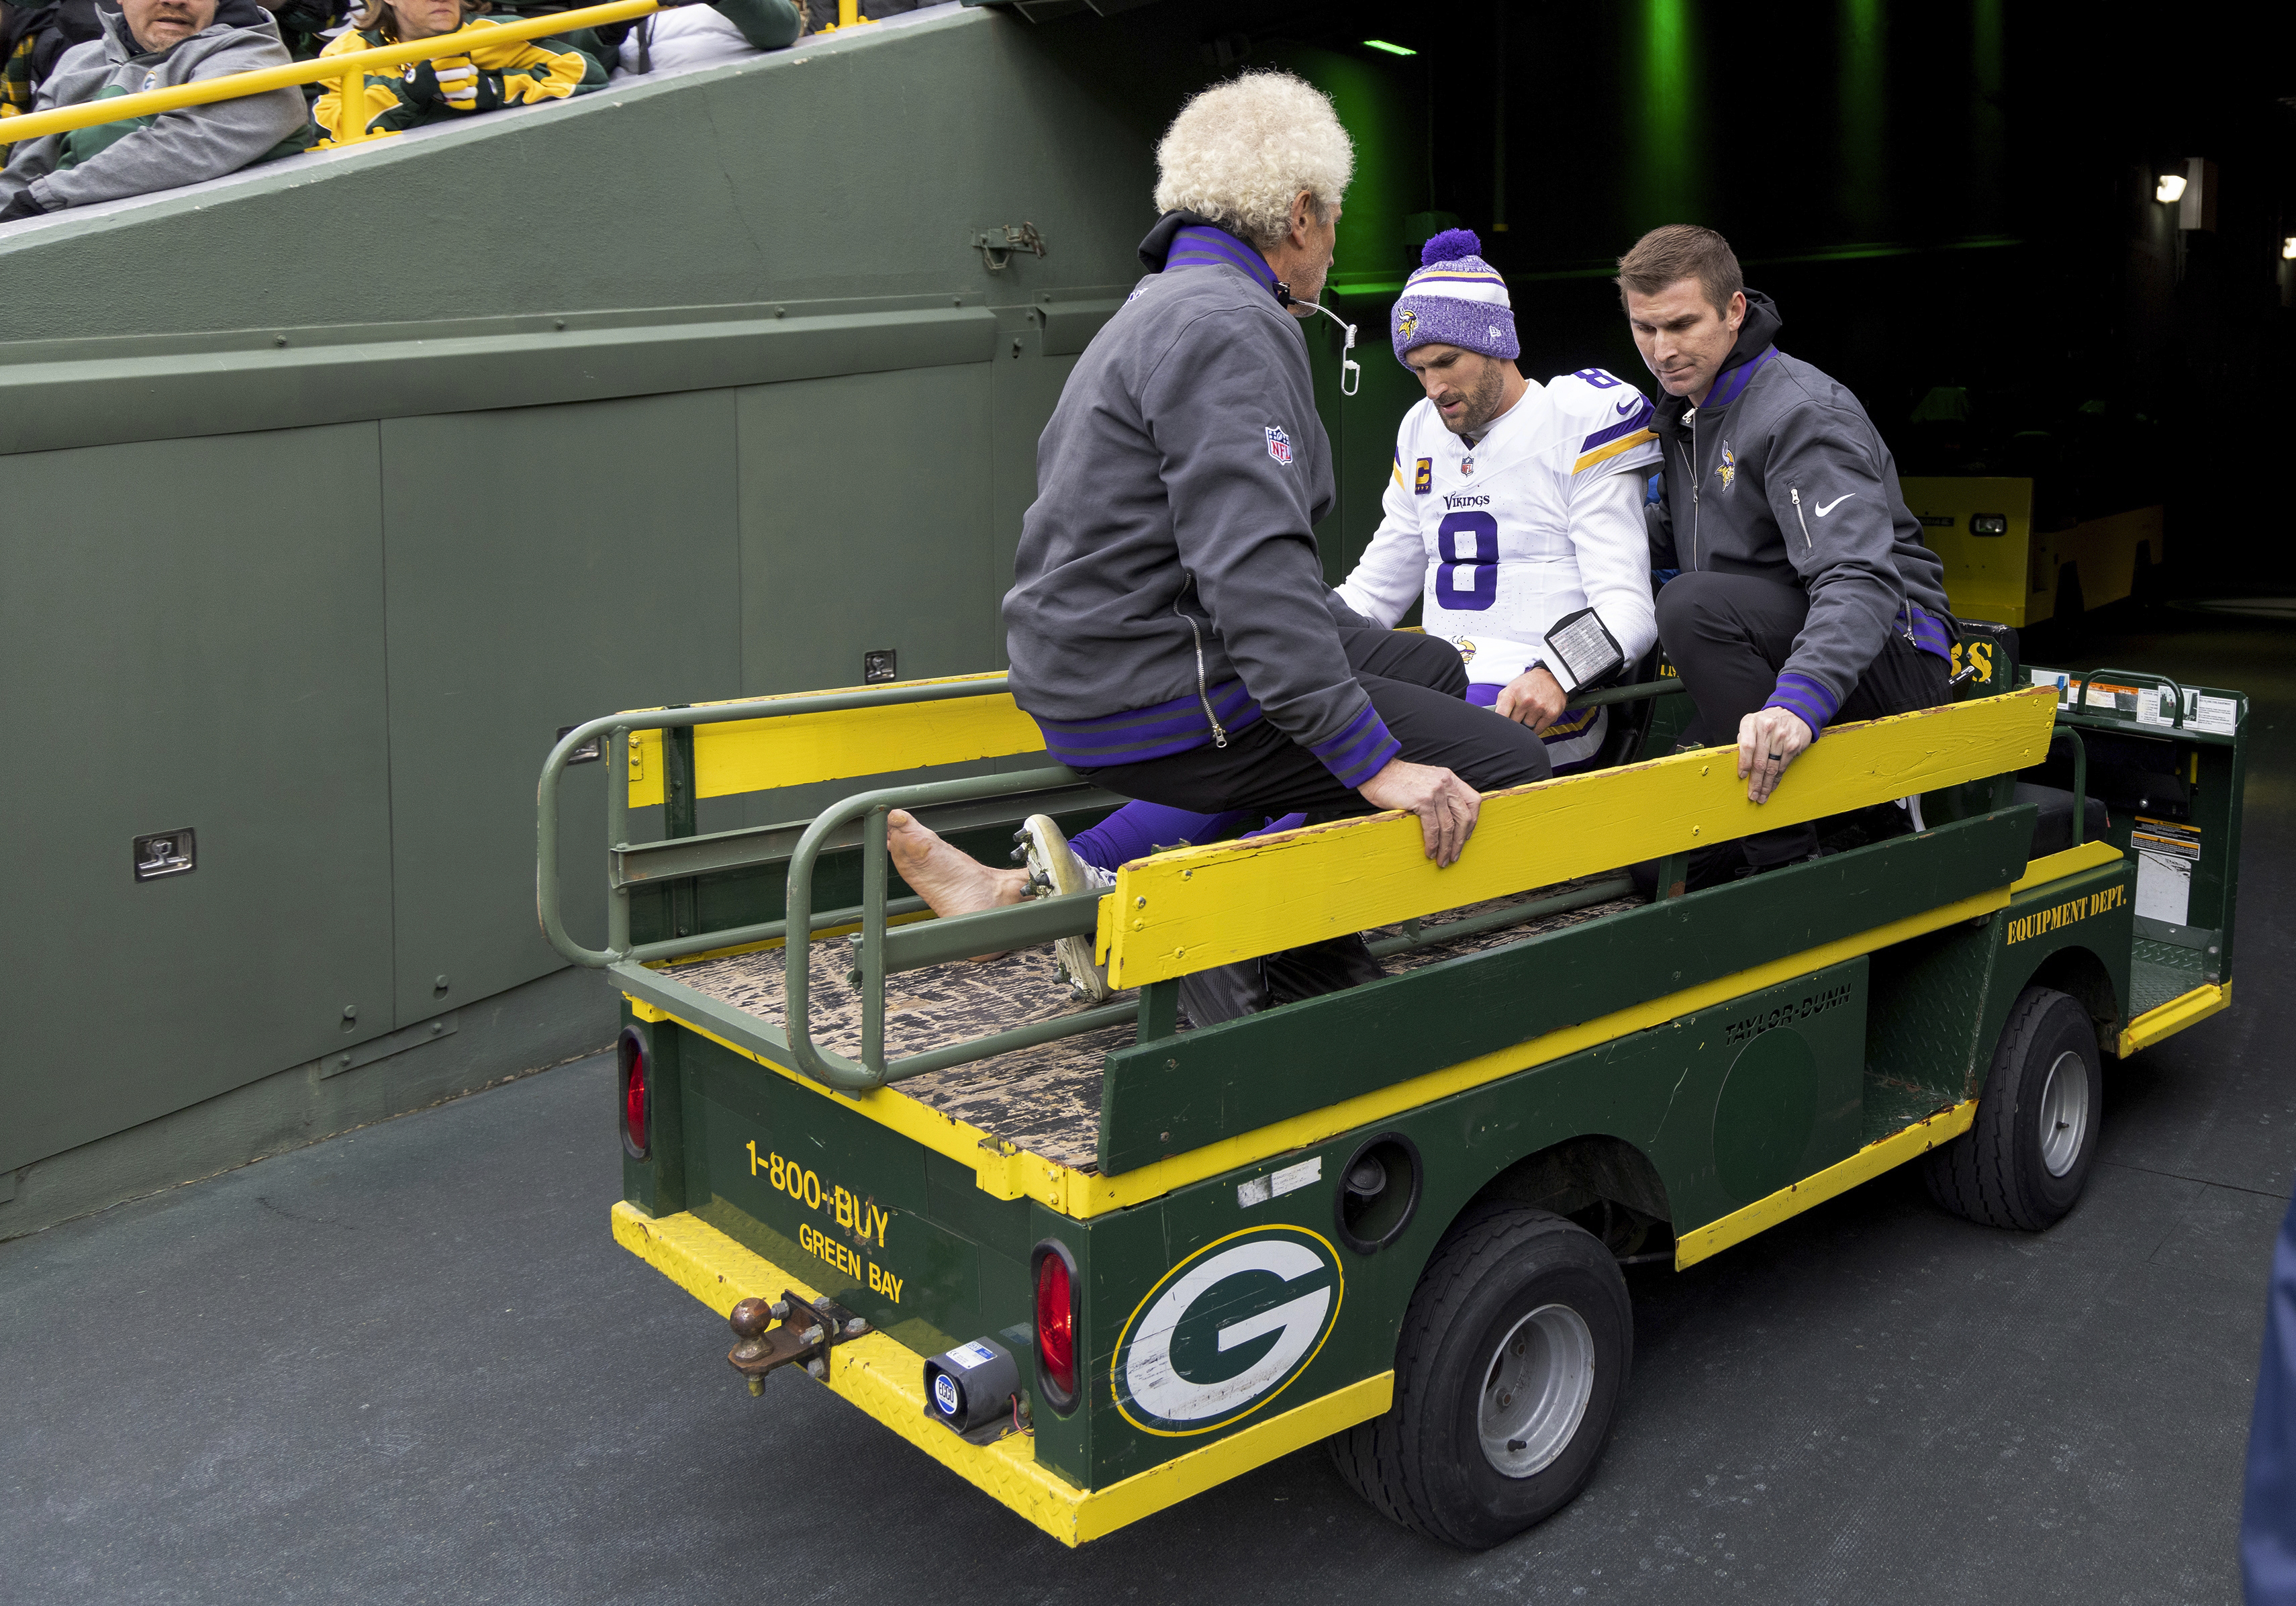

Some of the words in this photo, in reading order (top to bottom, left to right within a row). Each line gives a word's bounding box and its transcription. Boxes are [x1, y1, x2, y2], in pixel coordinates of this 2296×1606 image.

[1573, 367, 1622, 389] 8
[1271, 440, 1291, 460] NFL
[1462, 464, 1472, 473] NFL
[1416, 460, 1430, 485] C
[1435, 511, 1499, 611] 8
[2007, 896, 2088, 945] EQUIPMENT
[2091, 884, 2127, 916] DEPT.
[1725, 983, 1853, 1047] TAYLOR-DUNN
[799, 1223, 861, 1280] GREEN
[869, 1262, 903, 1304] BAY
[1126, 1240, 1331, 1421] G
[939, 1381, 954, 1403] ECCO
